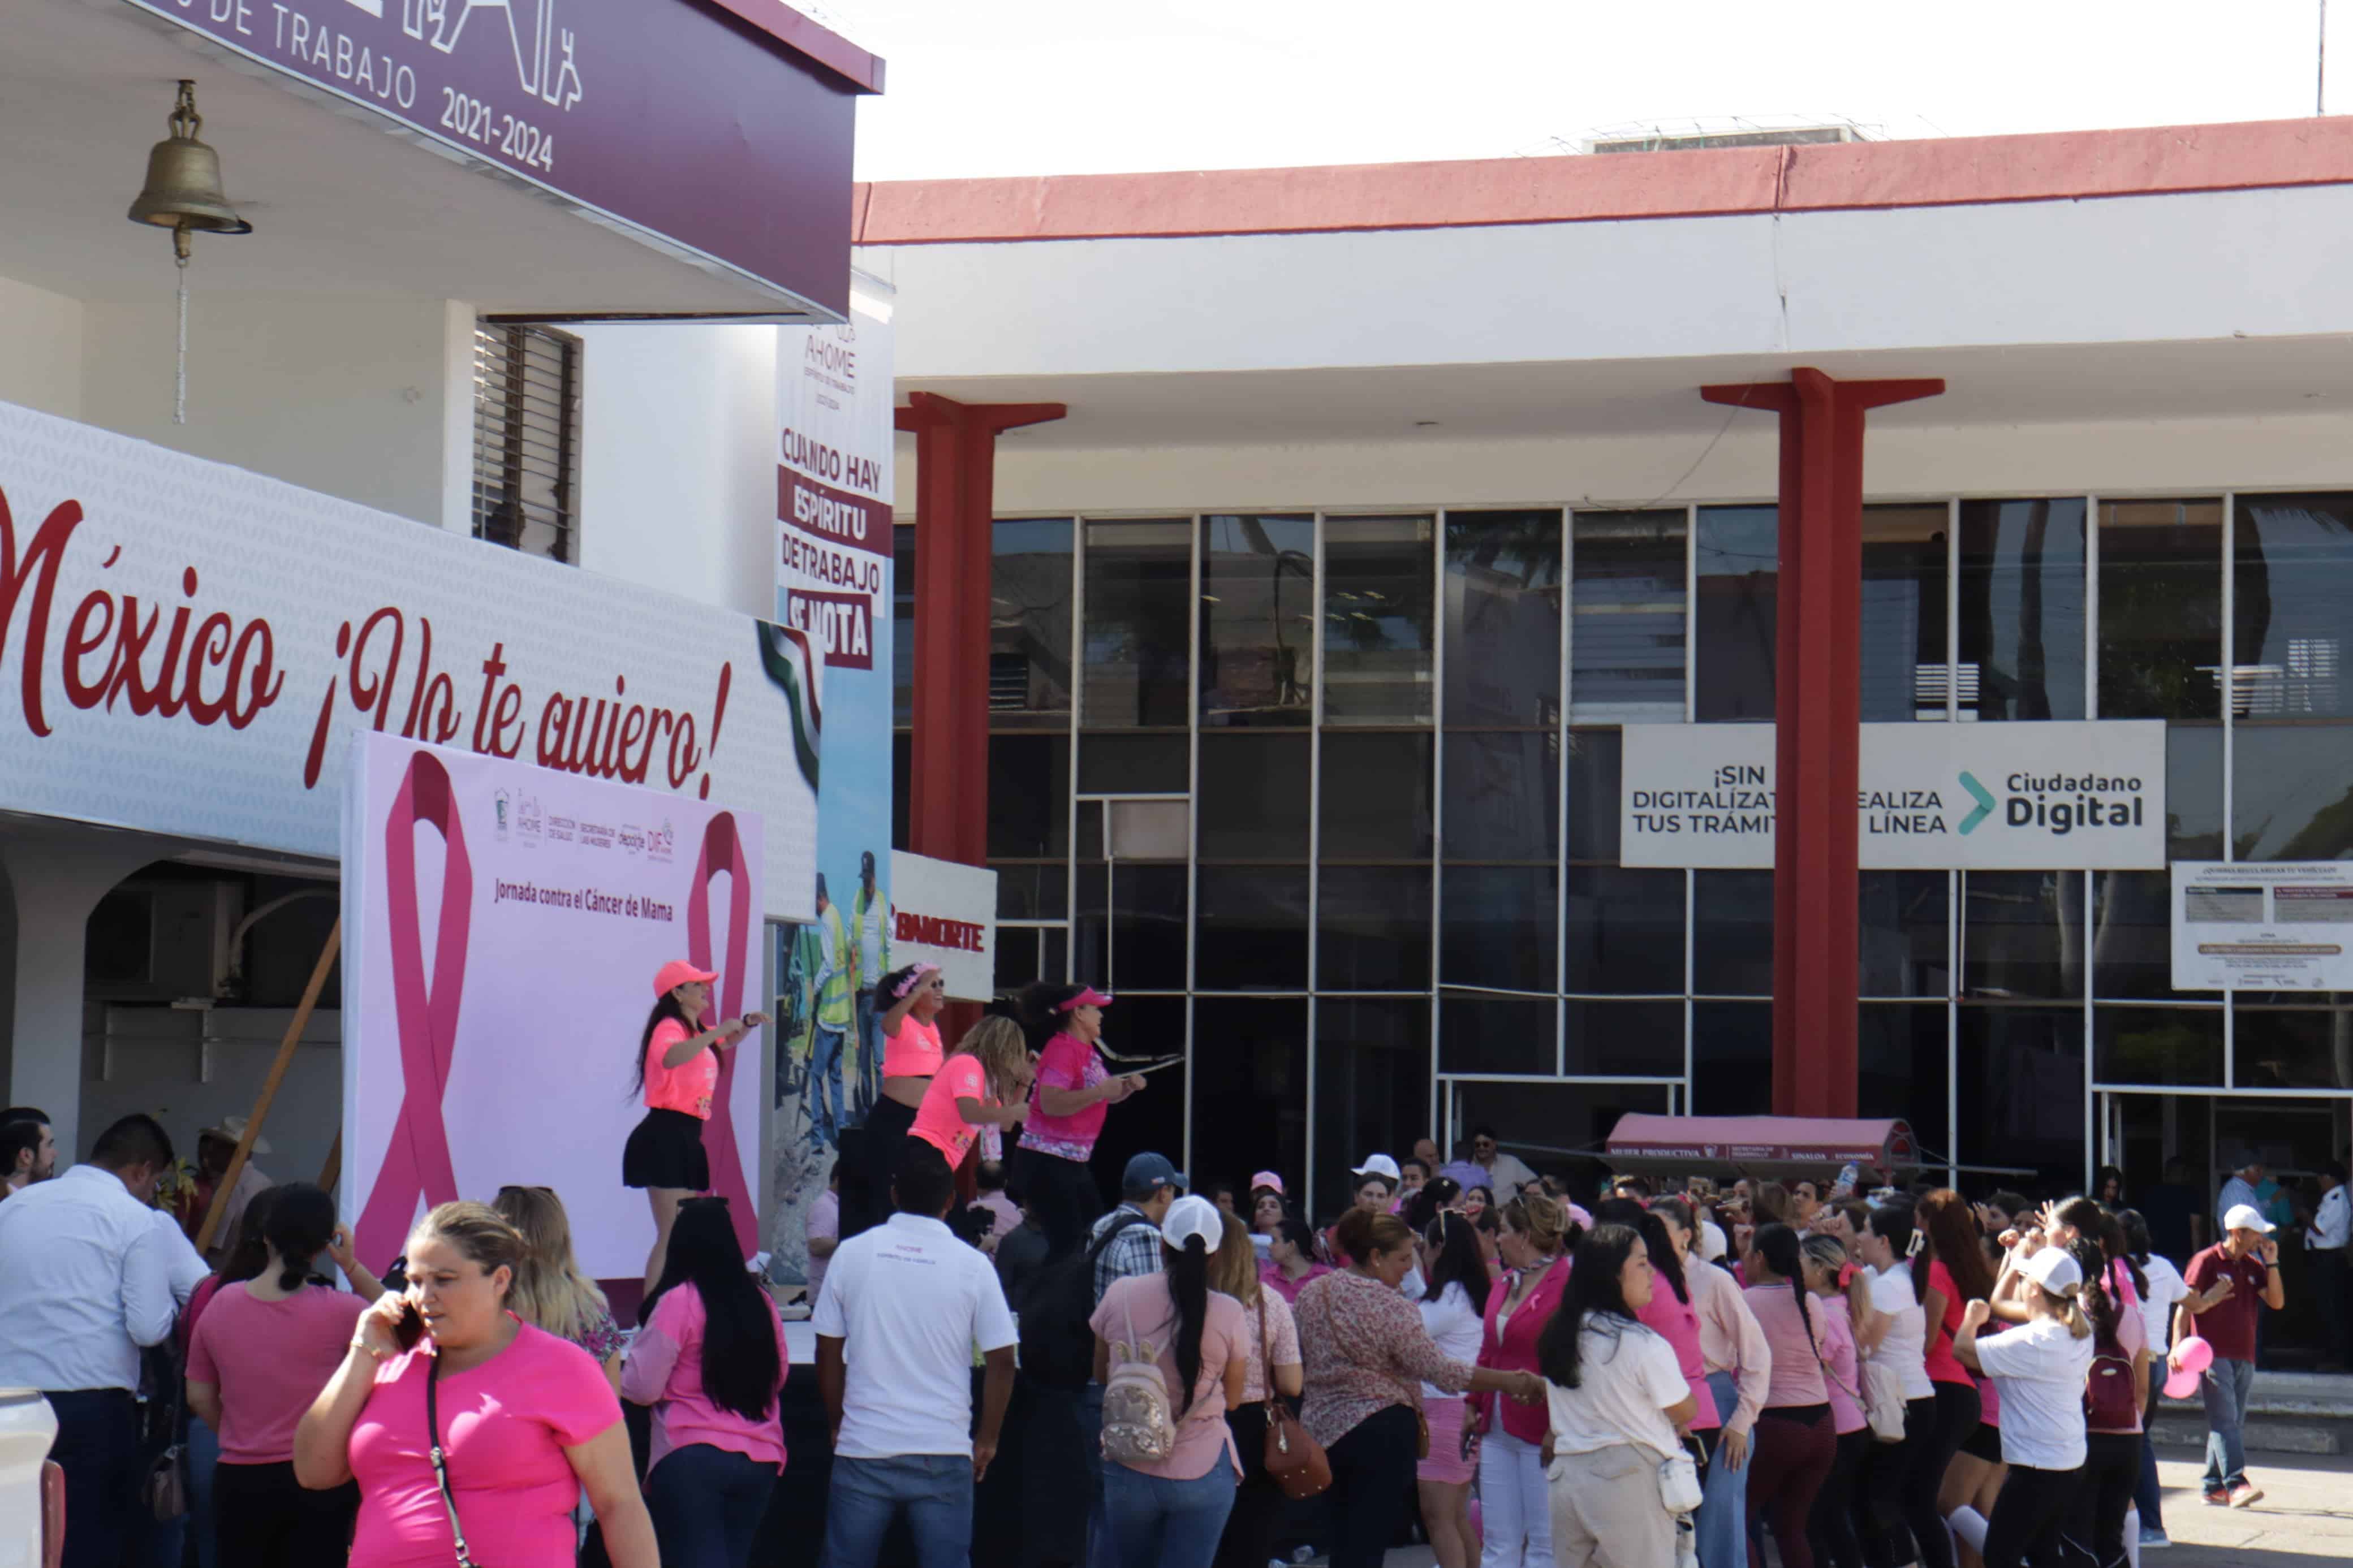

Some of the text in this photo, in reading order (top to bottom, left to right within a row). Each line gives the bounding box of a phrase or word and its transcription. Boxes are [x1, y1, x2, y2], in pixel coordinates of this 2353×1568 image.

[273, 3, 416, 109] TRABAJO
[441, 87, 553, 172] 2021-2024
[783, 427, 881, 493] CUANDO HAY
[794, 484, 866, 541] ESPÍRITU
[0, 482, 285, 737] México
[473, 642, 525, 759] te
[790, 596, 868, 656] SE NOTA
[1714, 766, 1765, 788] ¡SIN
[2007, 772, 2142, 792] Ciudadano
[1633, 815, 1680, 833] TUS
[1870, 810, 1947, 833] LÍNEA
[2007, 794, 2143, 835] Digital
[495, 878, 673, 922] Jornada contra el Cáncer de Mama
[1642, 1148, 1700, 1158] PRODUCTIVA
